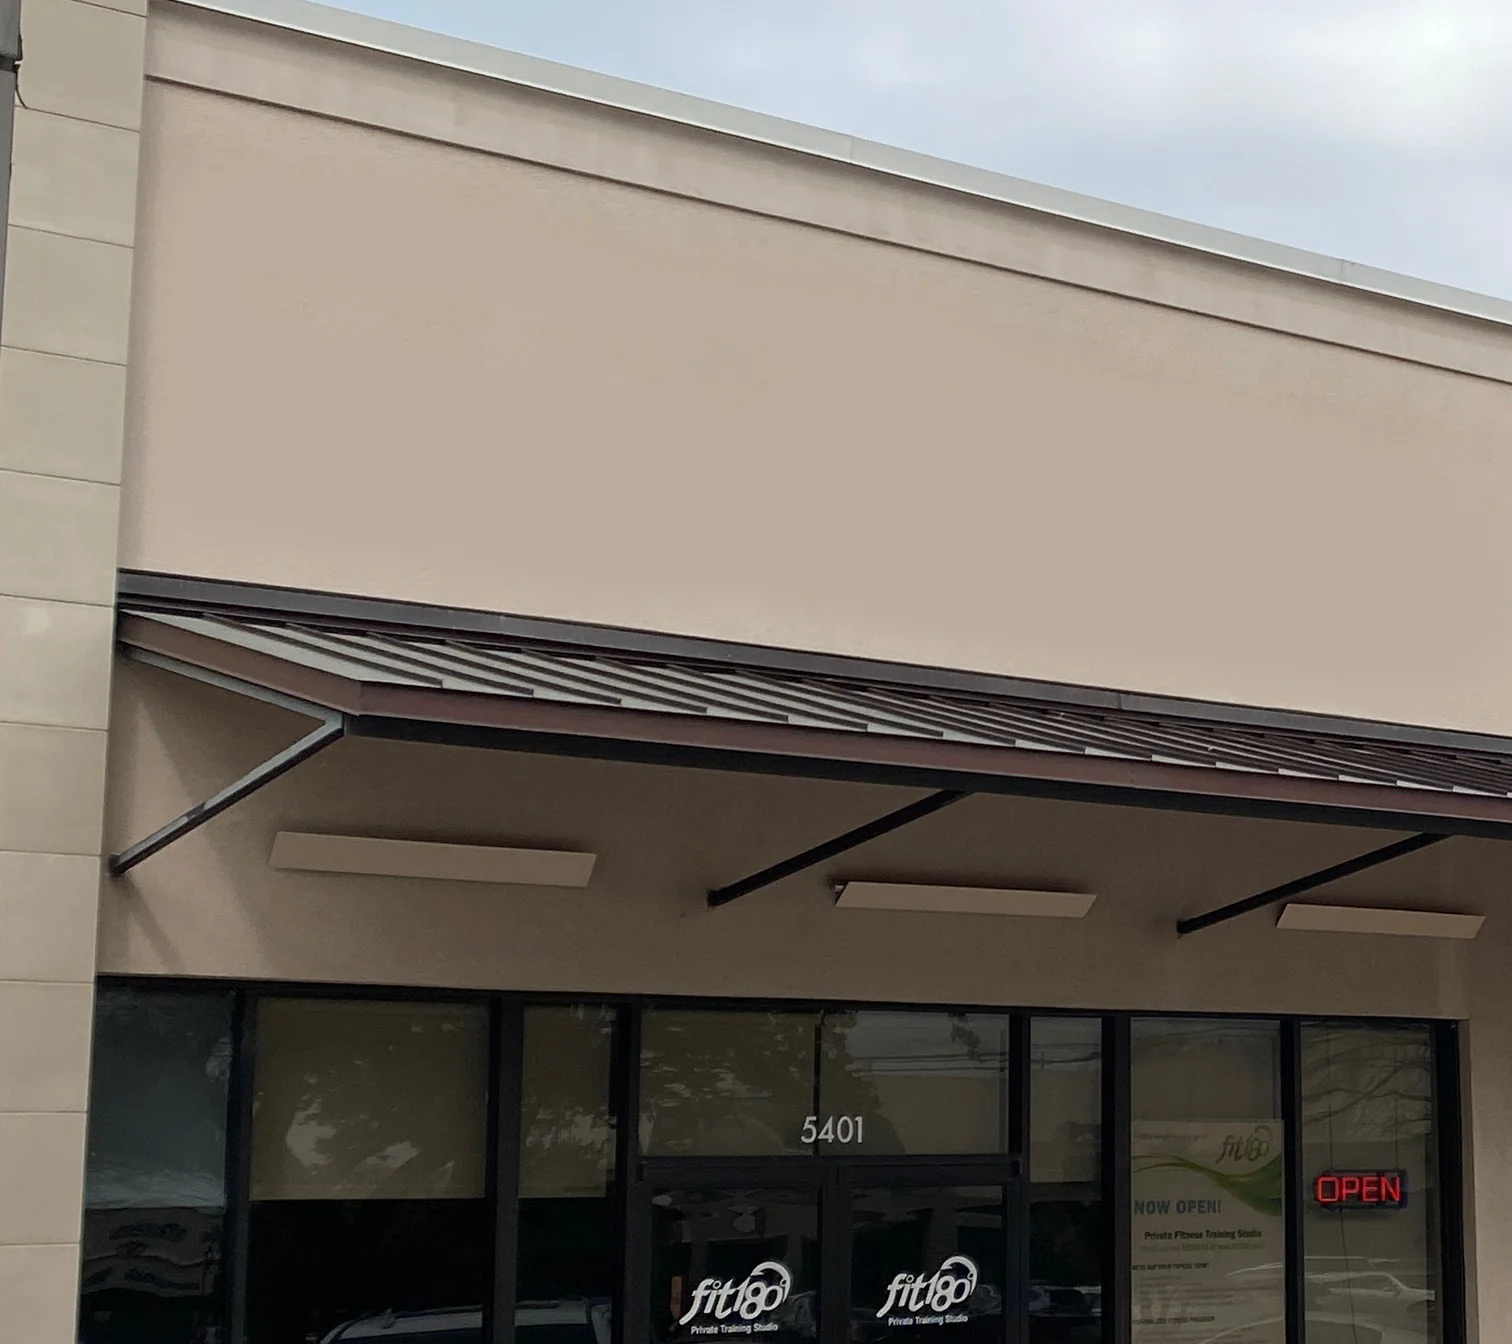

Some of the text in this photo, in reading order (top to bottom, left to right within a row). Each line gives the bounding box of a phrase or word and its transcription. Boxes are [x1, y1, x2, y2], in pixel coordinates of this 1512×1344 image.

[800, 1116, 863, 1144] 5401
[1317, 1176, 1401, 1202] OPEN
[1134, 1200, 1171, 1215] NOW
[1144, 1231, 1172, 1240] Private
[1205, 1229, 1236, 1240] Training
[1237, 1228, 1262, 1239] Studio
[888, 1314, 968, 1326] Private Training Studio
[690, 1322, 778, 1335] Private Training Studio
